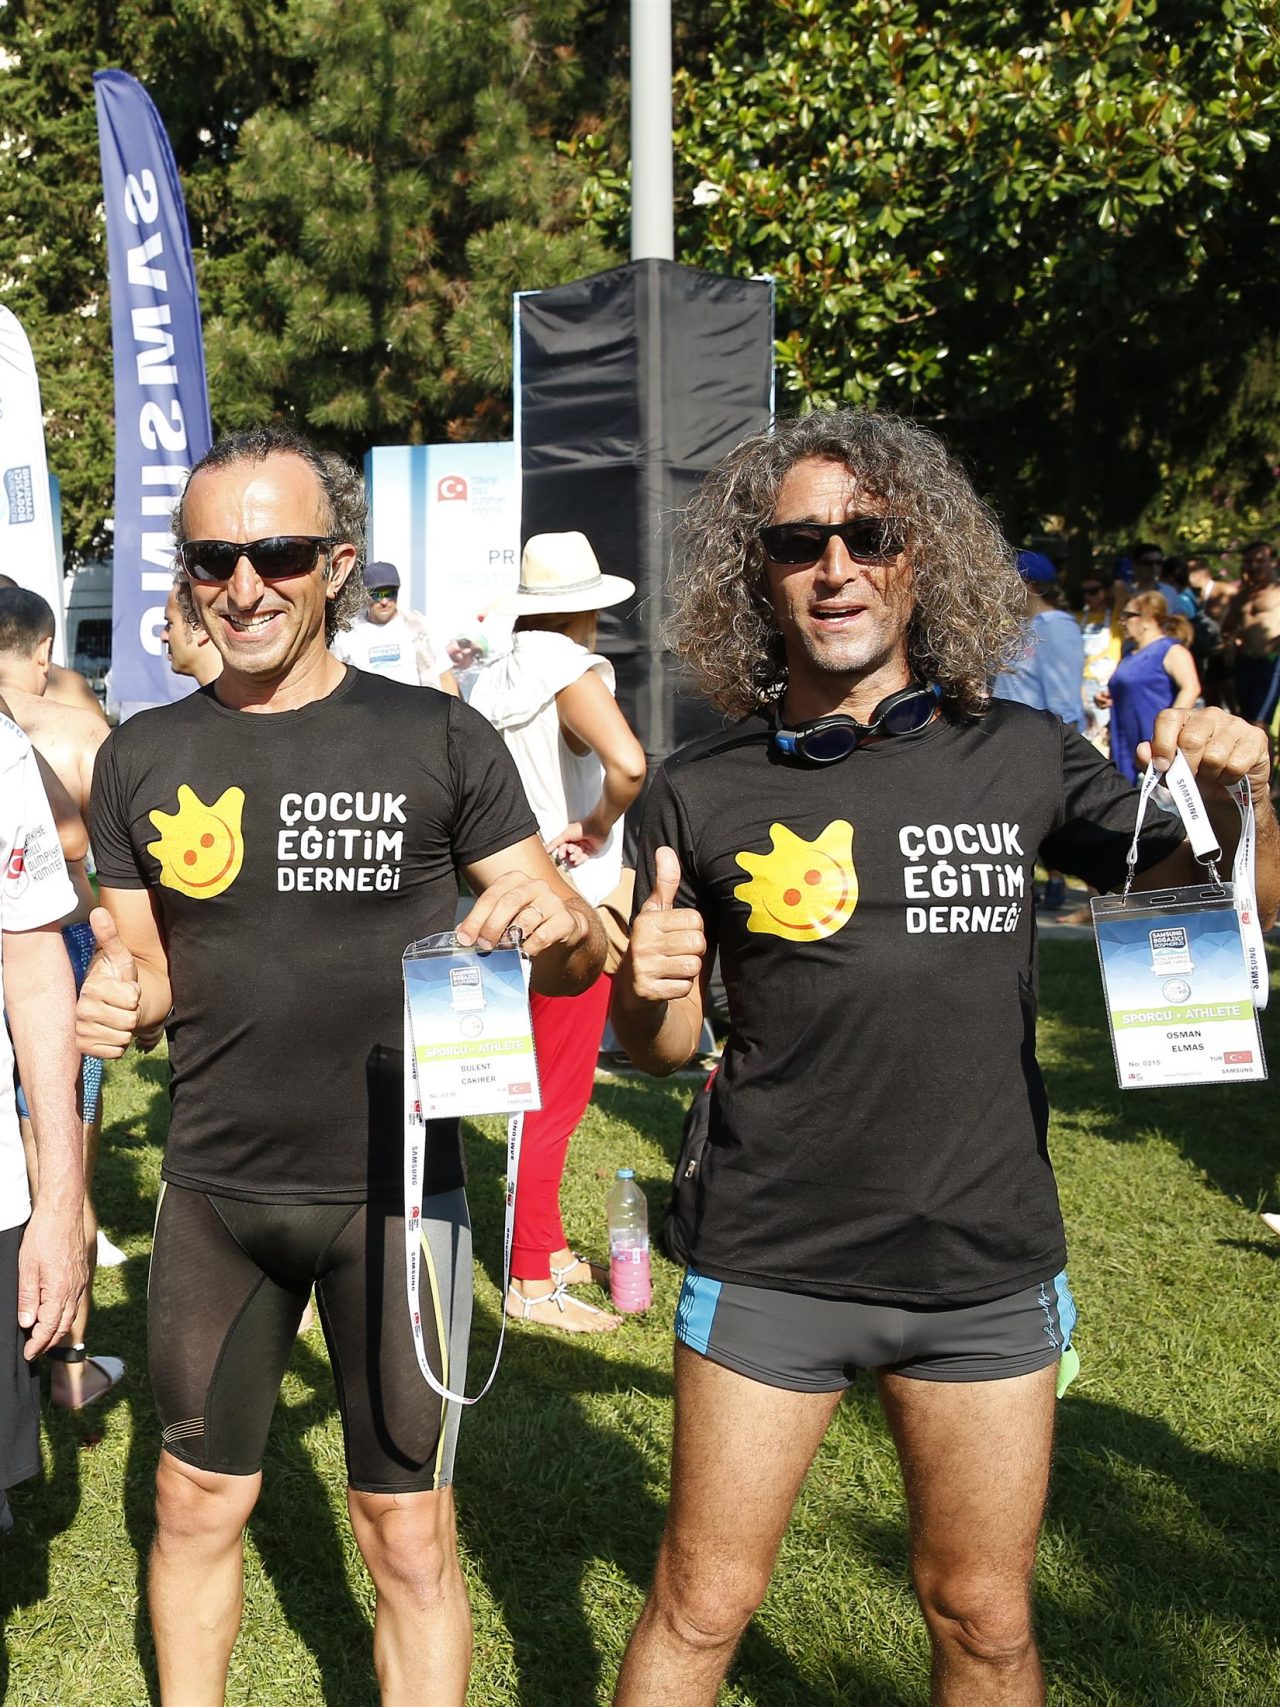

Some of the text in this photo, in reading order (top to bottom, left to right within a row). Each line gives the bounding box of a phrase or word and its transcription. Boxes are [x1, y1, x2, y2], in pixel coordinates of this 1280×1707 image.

[279, 791, 407, 826] ÇOCUK
[1177, 778, 1198, 820] SAMSUNG
[898, 822, 1024, 862] ÇOCUK
[1249, 947, 1260, 990] SAMSUNG
[1122, 1005, 1241, 1025] SPORCU ATHLETE
[1166, 1030, 1202, 1039] OSMAN
[1172, 1043, 1205, 1052] ELMAS
[425, 1040, 524, 1057] SPORCU ATHLETE
[460, 1063, 491, 1072] BULENT
[510, 1120, 518, 1161] SAMSUNG
